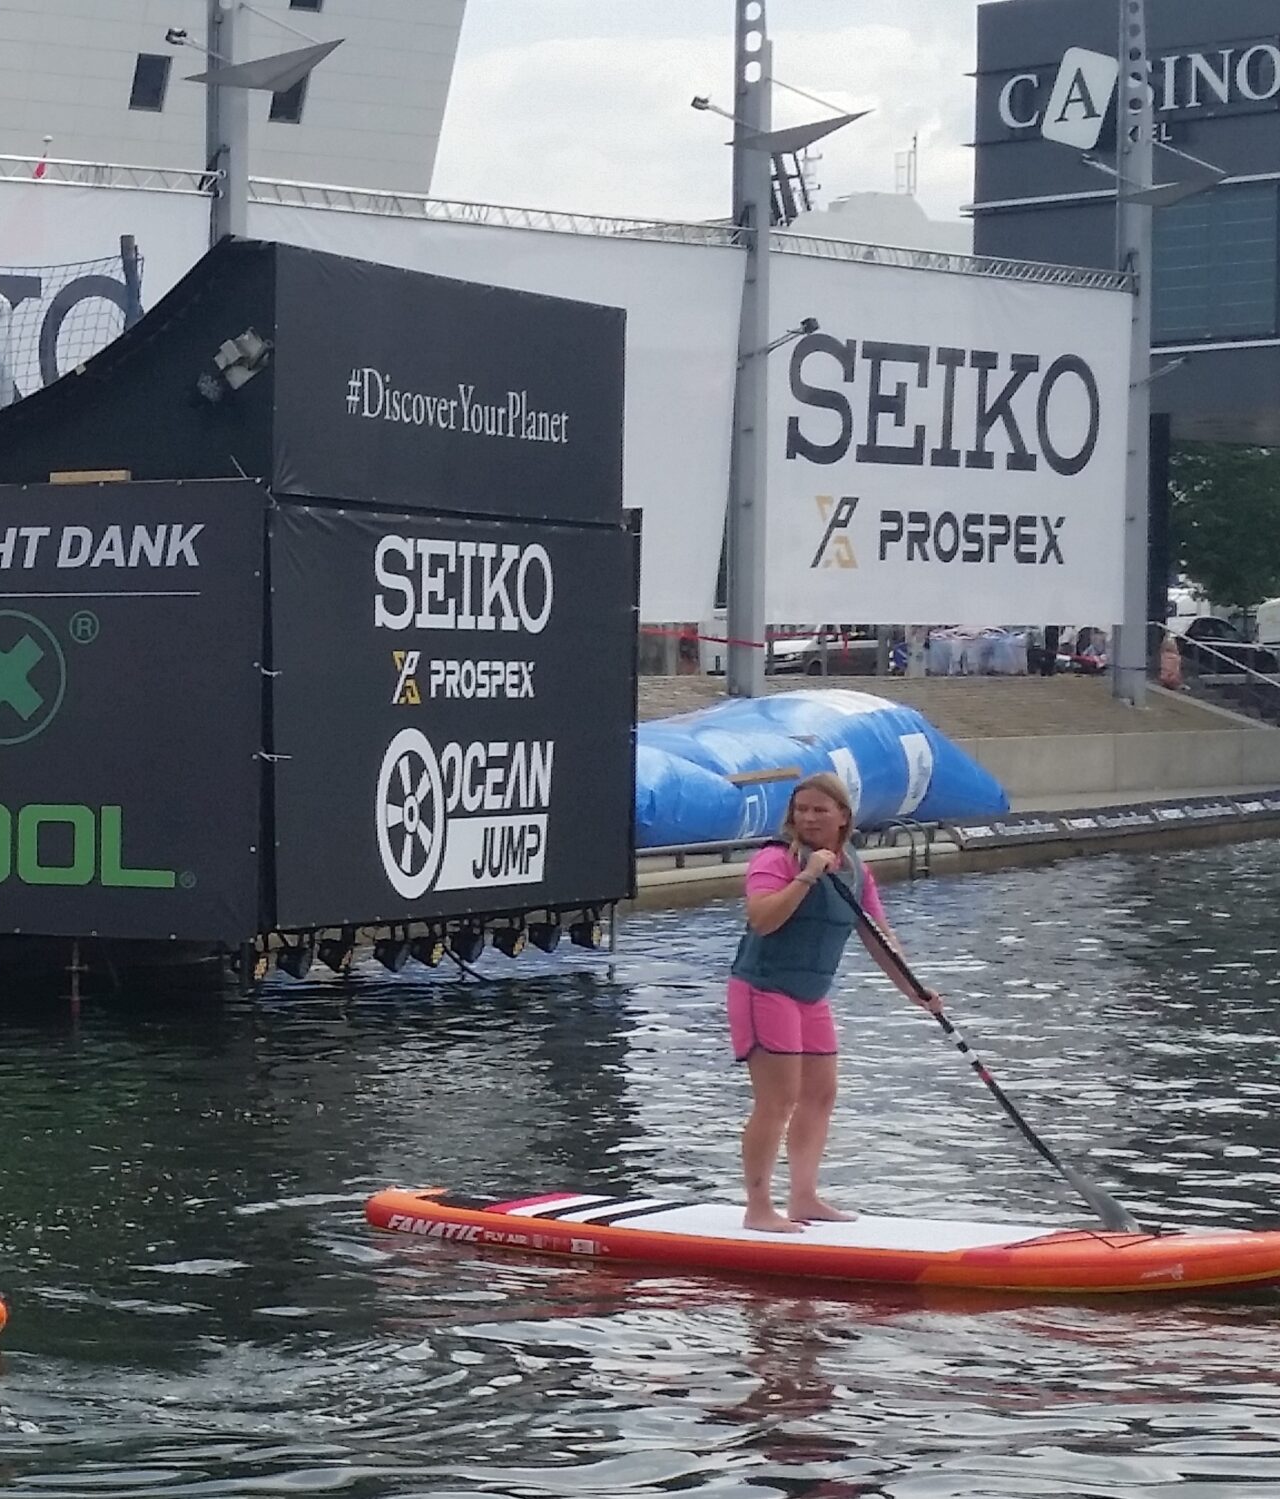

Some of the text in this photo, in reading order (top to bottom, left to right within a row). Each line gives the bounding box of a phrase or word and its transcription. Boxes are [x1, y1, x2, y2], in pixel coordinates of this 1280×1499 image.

[346, 367, 569, 443] #DiscoverYourPlanet
[786, 333, 1100, 476] SEIKO
[56, 523, 204, 569] DANK
[878, 510, 1066, 565] PROSPEX
[374, 534, 554, 634] SEIKO
[429, 659, 536, 699] PROSPEX
[441, 740, 555, 813] OCEAN
[472, 824, 542, 880] JUMP
[387, 1214, 484, 1242] FANATIC
